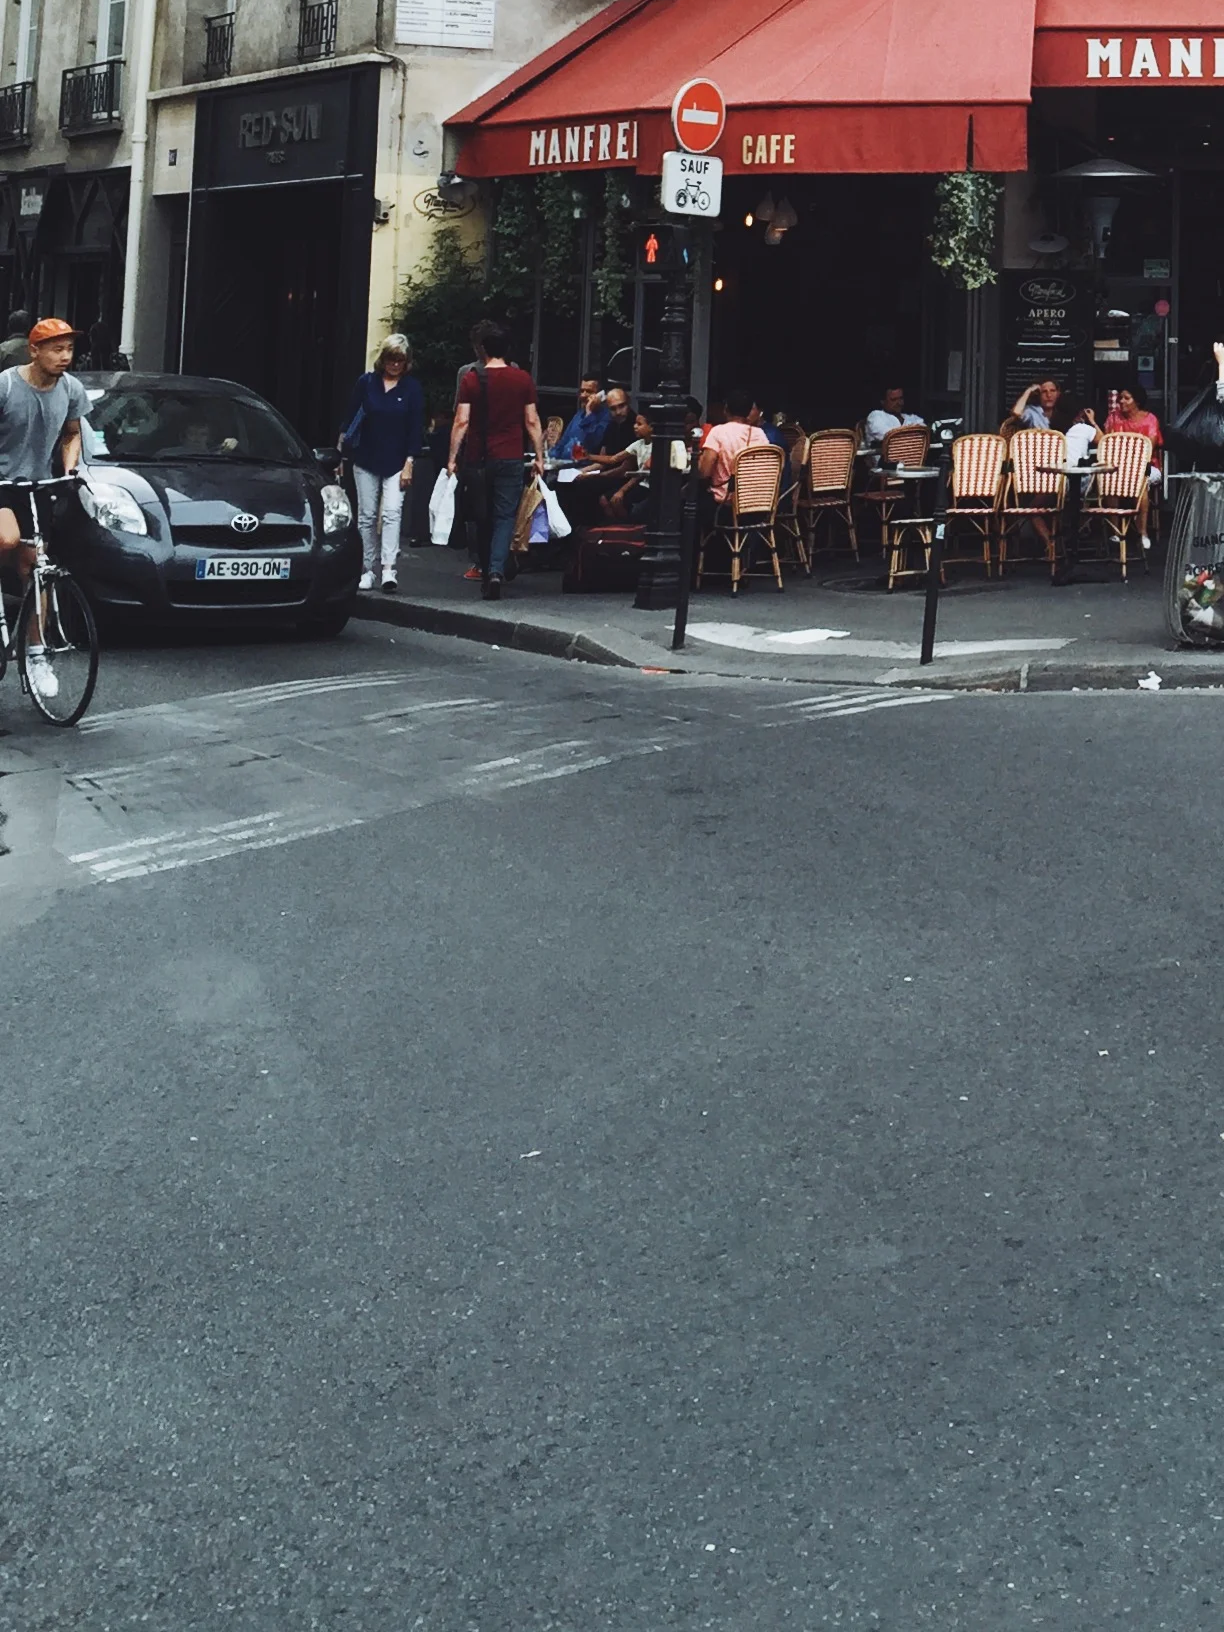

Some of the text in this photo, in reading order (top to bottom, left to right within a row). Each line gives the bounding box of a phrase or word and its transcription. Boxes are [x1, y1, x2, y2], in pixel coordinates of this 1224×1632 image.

[742, 134, 796, 165] CAFE
[680, 158, 711, 176] SAUF
[206, 560, 281, 577] AE-930-QN
